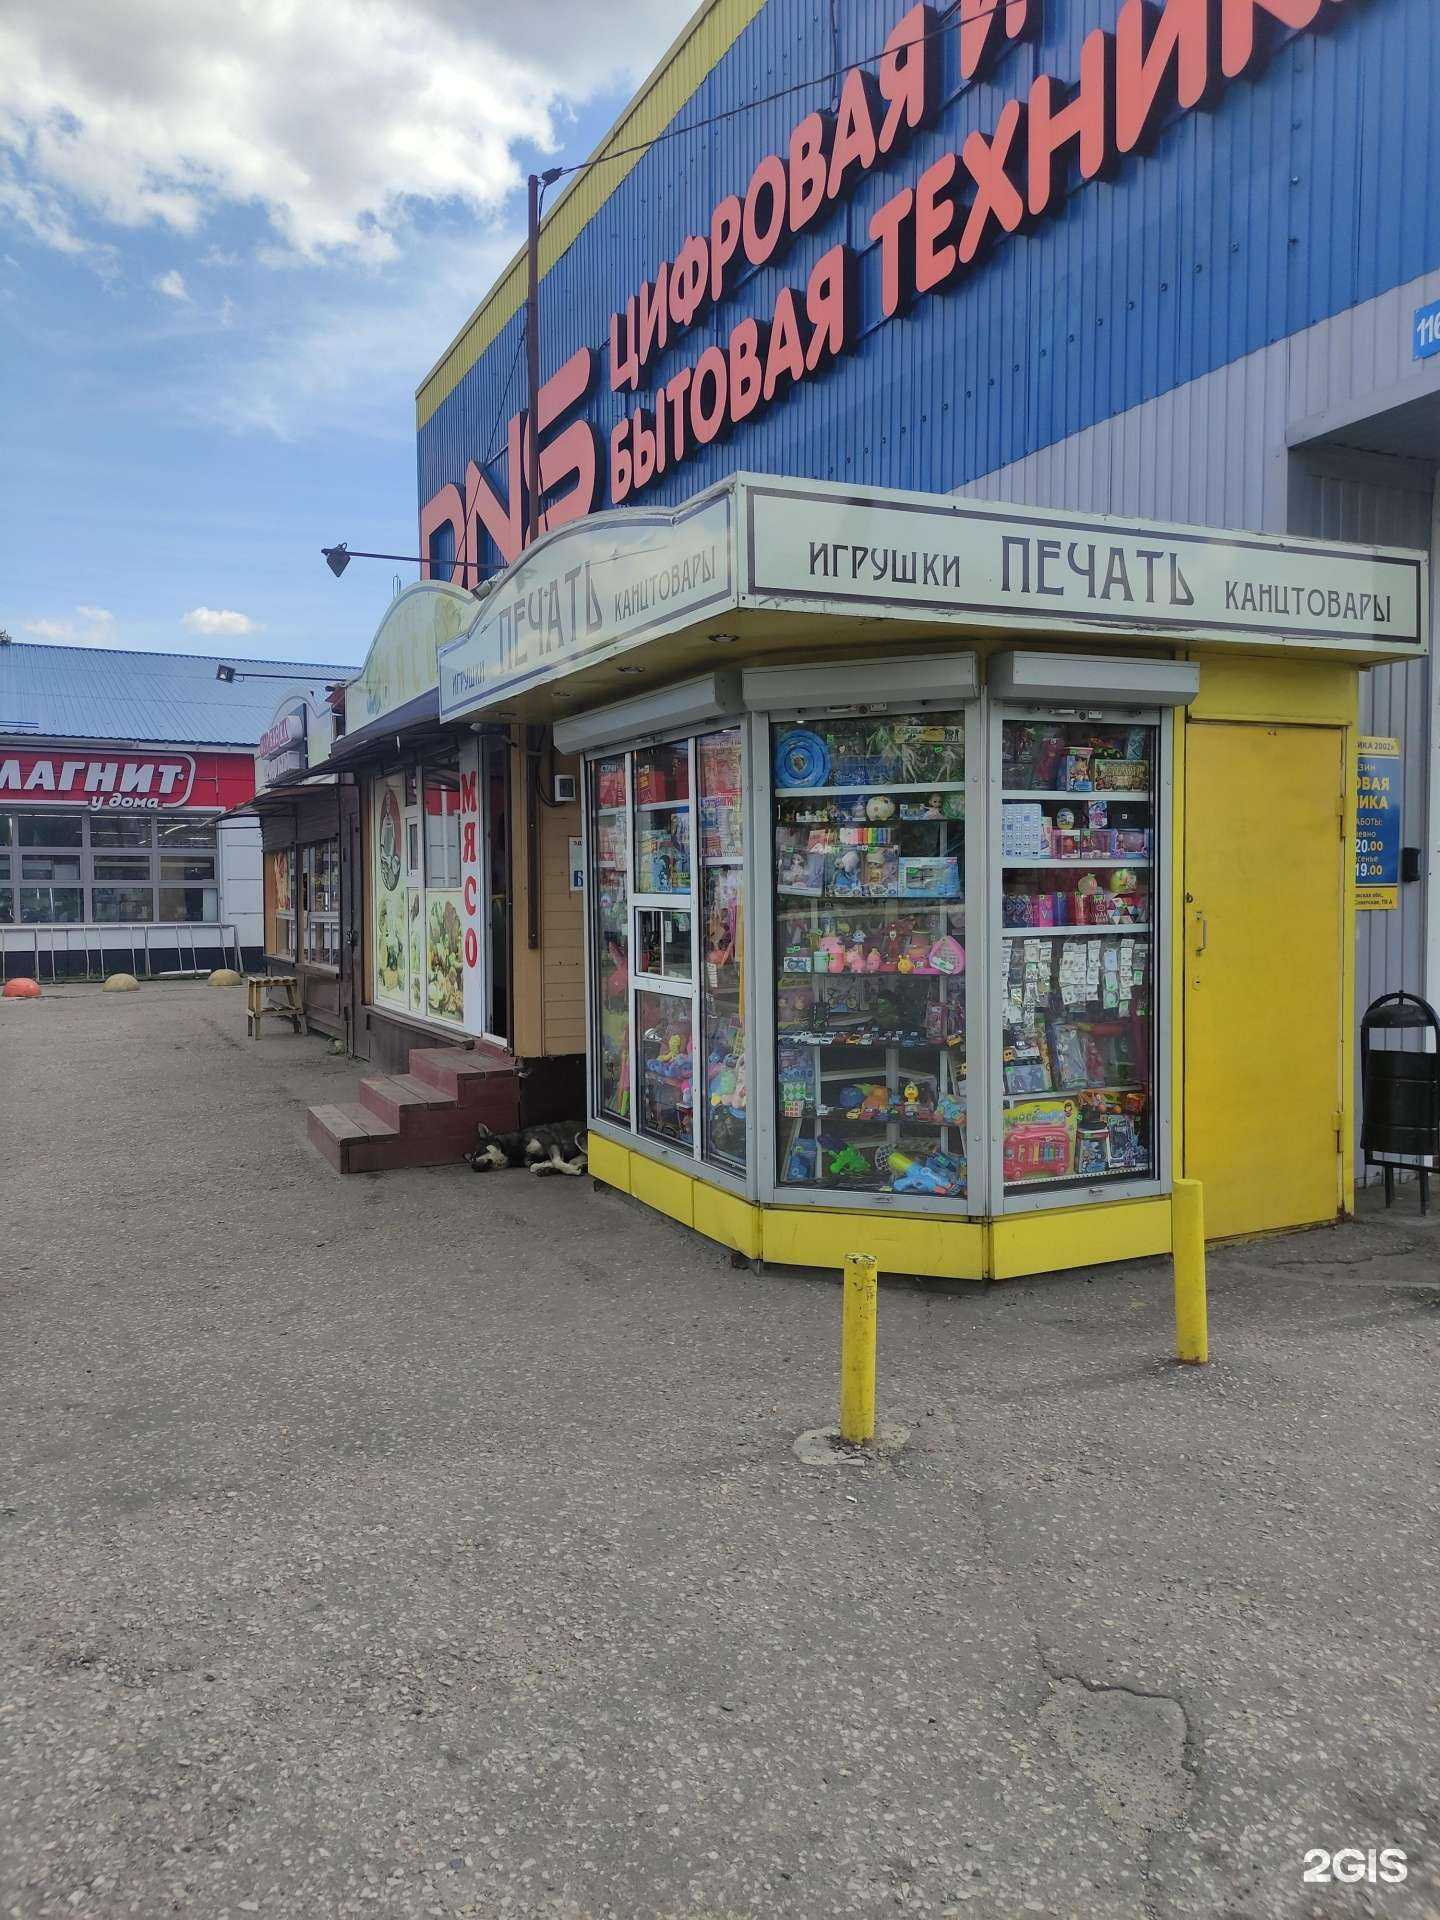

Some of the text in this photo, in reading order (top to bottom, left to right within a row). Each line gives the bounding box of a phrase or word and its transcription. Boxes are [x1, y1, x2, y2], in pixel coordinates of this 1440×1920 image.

[611, 3, 925, 391] ЦИФРОВАЯ
[421, 346, 596, 590] DNS
[611, 246, 843, 504] БЫТОВАЯ
[452, 663, 485, 696] ИГРУШКИ
[499, 560, 603, 674] ПЕЧАТЬ
[614, 545, 716, 622] КАНЦТОВАРЫ
[809, 535, 1392, 622] ИГРУШКИ ПЕЧАТЬ КАНЦТОВАРЫ
[91, 793, 159, 811] у дома
[461, 770, 478, 969] МЯСО
